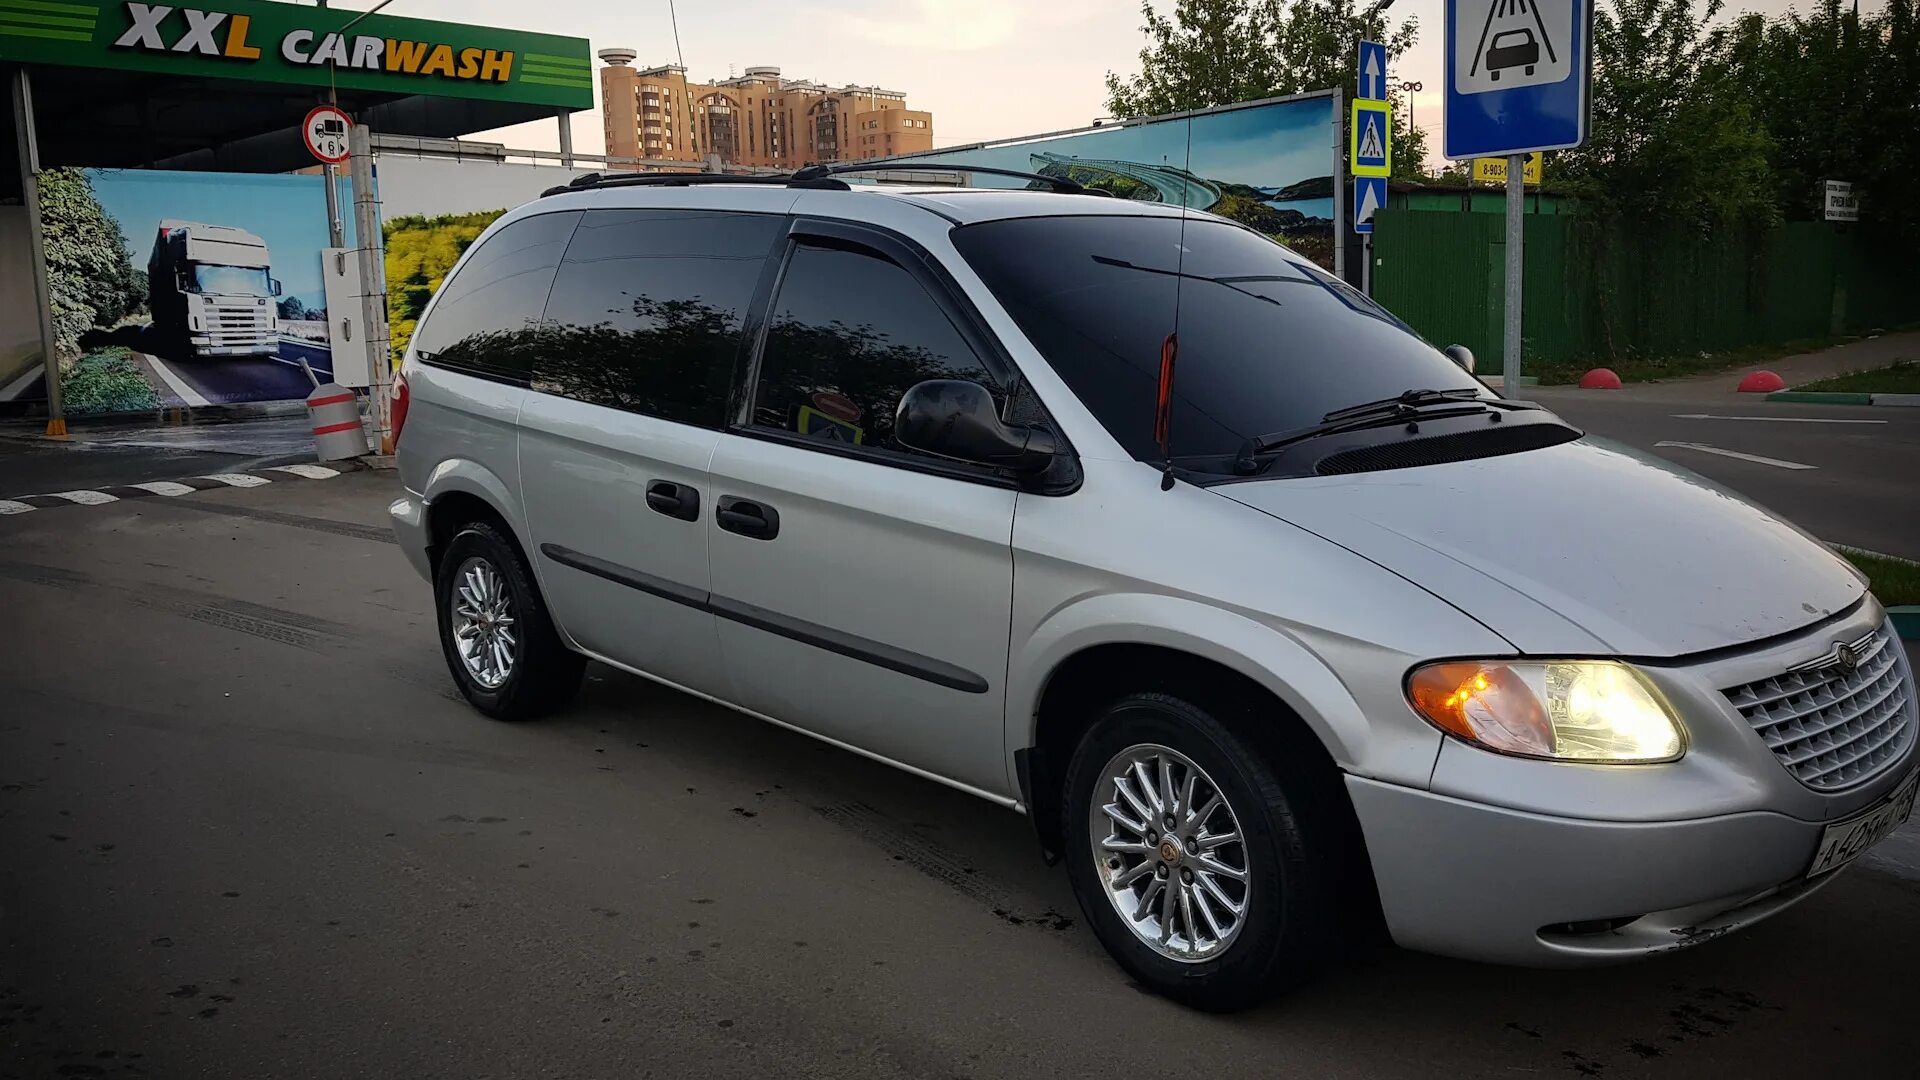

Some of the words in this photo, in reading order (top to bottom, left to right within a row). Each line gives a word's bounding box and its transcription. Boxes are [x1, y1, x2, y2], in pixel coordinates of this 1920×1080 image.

[114, 2, 261, 60] XXL
[281, 29, 514, 82] CARWASH
[328, 140, 335, 152] 6
